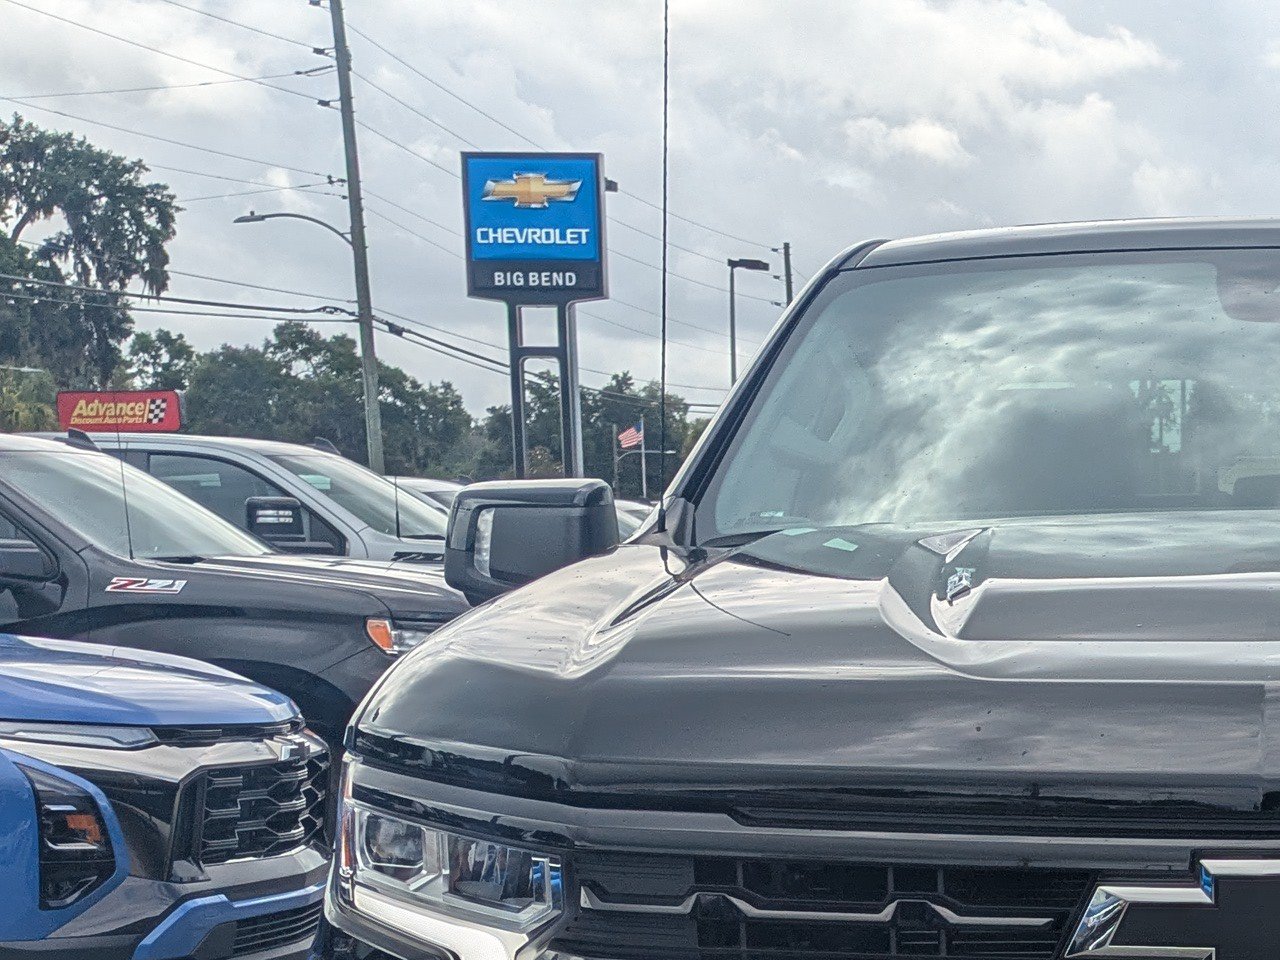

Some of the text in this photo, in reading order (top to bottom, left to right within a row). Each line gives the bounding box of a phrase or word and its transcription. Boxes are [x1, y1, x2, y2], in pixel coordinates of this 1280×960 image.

[476, 227, 590, 245] CHEVROLET
[494, 271, 577, 286] BIG BEND
[72, 399, 145, 417] Advance
[105, 576, 188, 594] Z71
